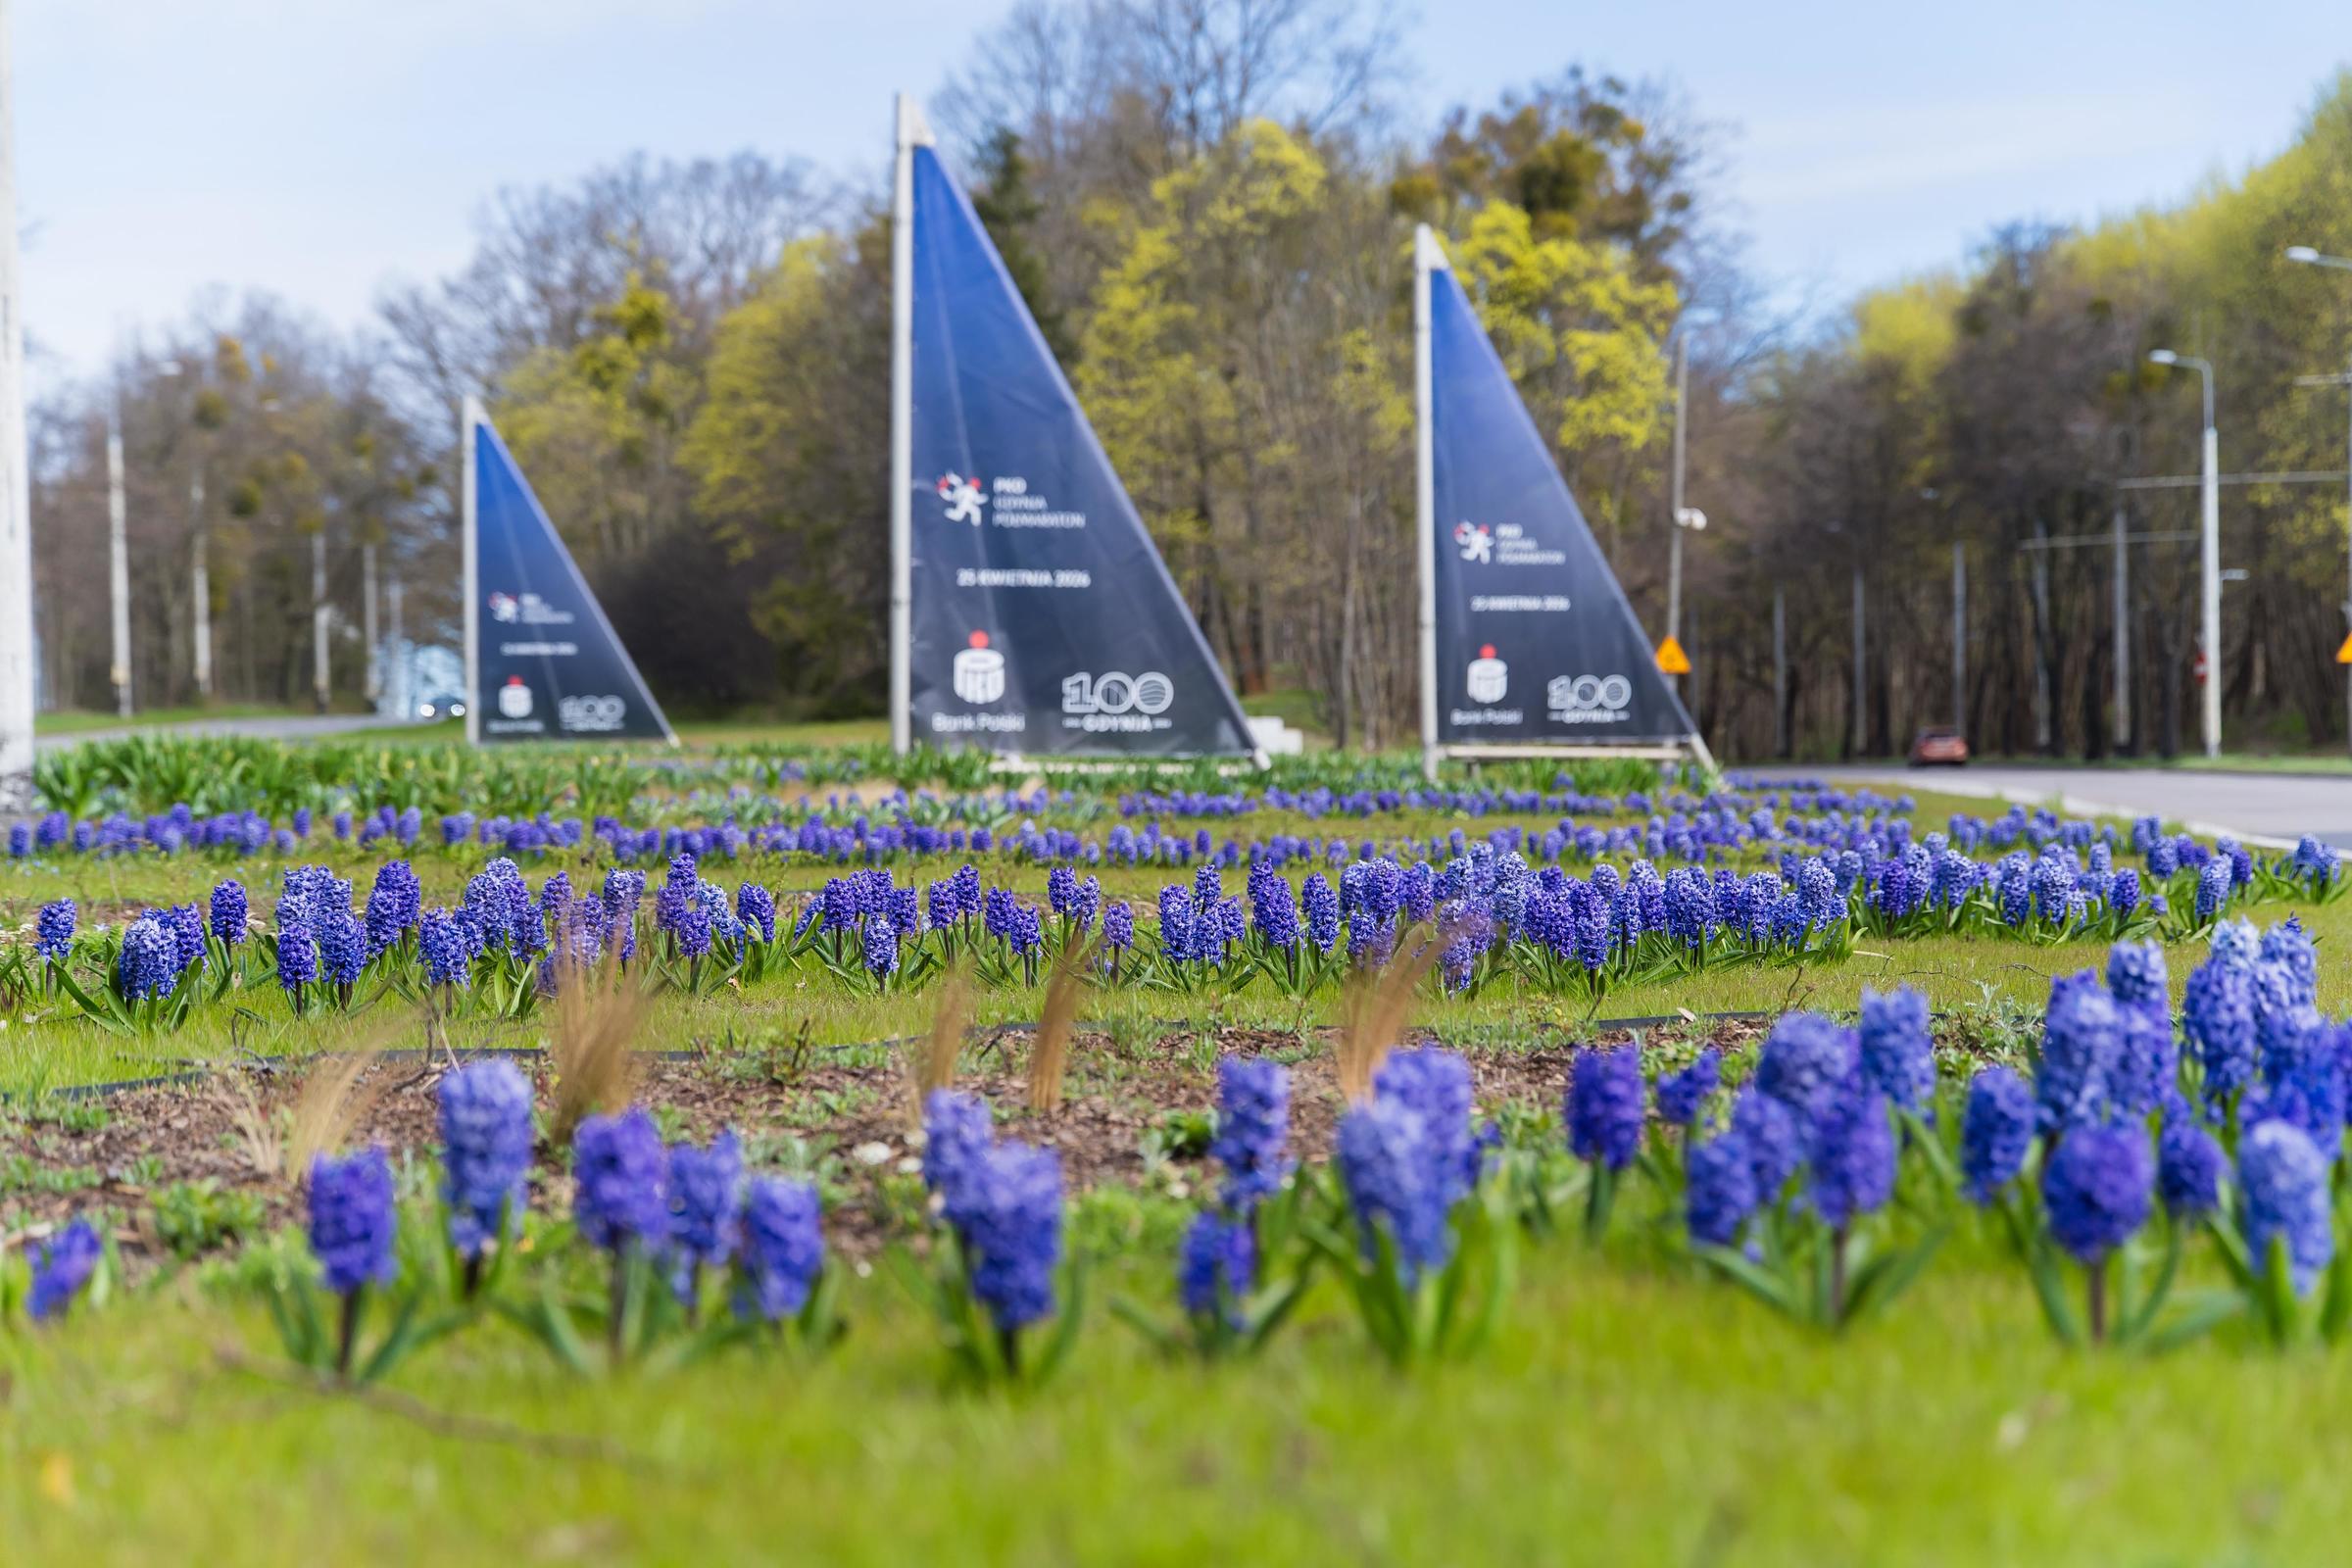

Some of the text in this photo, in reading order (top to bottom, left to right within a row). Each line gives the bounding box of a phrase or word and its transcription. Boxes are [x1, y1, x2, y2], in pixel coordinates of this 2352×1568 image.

[993, 476, 1027, 495] PKO
[1061, 671, 1174, 714] 100
[1546, 674, 1632, 710] 100
